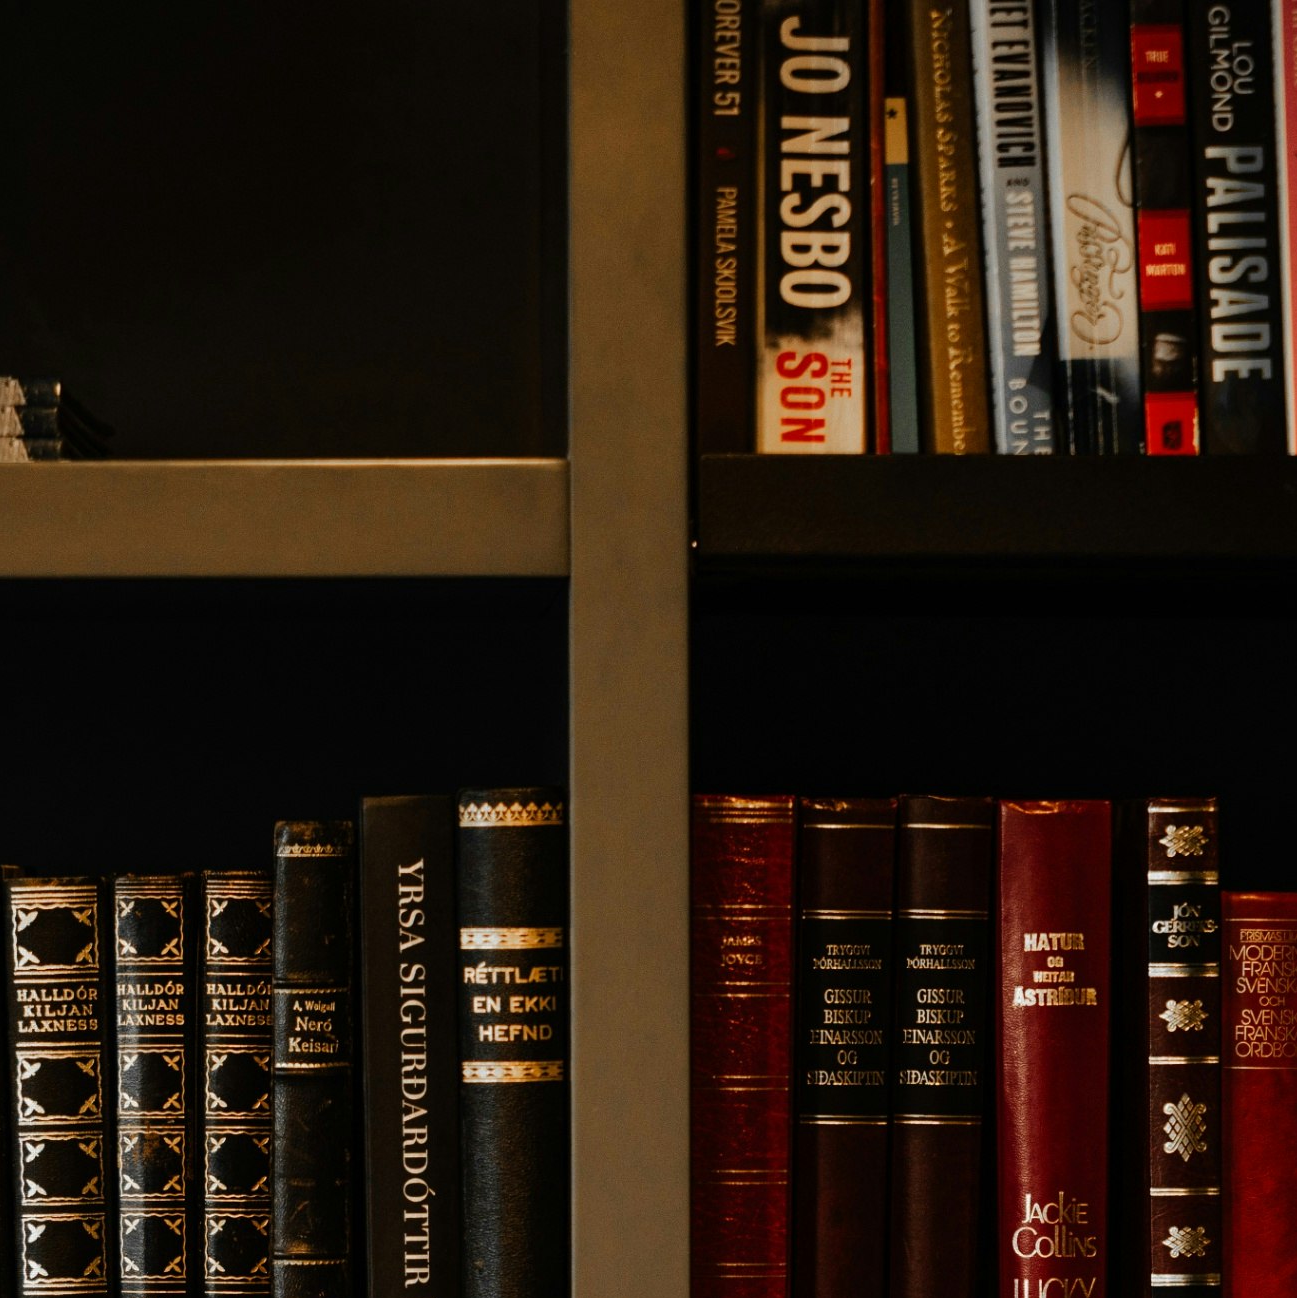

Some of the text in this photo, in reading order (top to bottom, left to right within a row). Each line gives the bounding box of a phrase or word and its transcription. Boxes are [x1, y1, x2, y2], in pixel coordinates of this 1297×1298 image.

[1207, 5, 1234, 133] GILMOND
[1231, 41, 1254, 95] LOU
[713, 90, 742, 116] 51
[991, 40, 1035, 168] EVANOVICH
[779, 15, 852, 309] JO NESBO
[929, 8, 971, 319] NICHOLAS SPARKS Walk
[714, 186, 738, 347] PAMELA SKJOLSVIK
[1204, 145, 1273, 383] PALISADE
[1006, 190, 1041, 357] STEVE HAMILTON
[776, 351, 851, 443] THE SON
[397, 857, 426, 954] YRSA
[1172, 901, 1202, 920] JÓN
[1023, 932, 1085, 952] HATUR
[1167, 934, 1200, 949] SON
[1239, 930, 1282, 942] PRISMAS
[826, 944, 871, 956] TRYGGVI
[918, 944, 964, 956] TRYGGVI
[720, 953, 763, 967] JOYCE
[1046, 955, 1063, 969] OG
[463, 961, 564, 985] RÉTTLÆTI
[1032, 971, 1075, 983] HEITAR
[16, 984, 98, 1003] HALLDÓR
[116, 980, 185, 996] HALLDÓR
[823, 988, 872, 1004] GISSUR
[916, 988, 966, 1004] GISSUR
[1012, 985, 1098, 1007] ÁSTRÍÐUR
[122, 998, 179, 1011] KILJAN
[211, 998, 270, 1012] KILJAN
[472, 996, 557, 1014] EN EKKI
[1258, 995, 1286, 1007] OCH
[22, 1003, 94, 1018] KILJAN
[823, 1008, 872, 1025] BISKUP
[915, 1008, 964, 1025] BISKUP
[17, 1018, 99, 1034] LAXNESS
[117, 1013, 185, 1027] LAXNESS
[205, 1013, 273, 1027] LAXNESS
[295, 1015, 333, 1033] Neró
[478, 1024, 553, 1042] HEFND
[810, 1029, 883, 1045] EINARSSON
[903, 1029, 976, 1045] EINARSSON
[287, 1036, 340, 1054] Keisari
[837, 1049, 858, 1065] OG
[929, 1049, 951, 1065] OG
[399, 962, 436, 1288] SIGURÐARDÓTTIR
